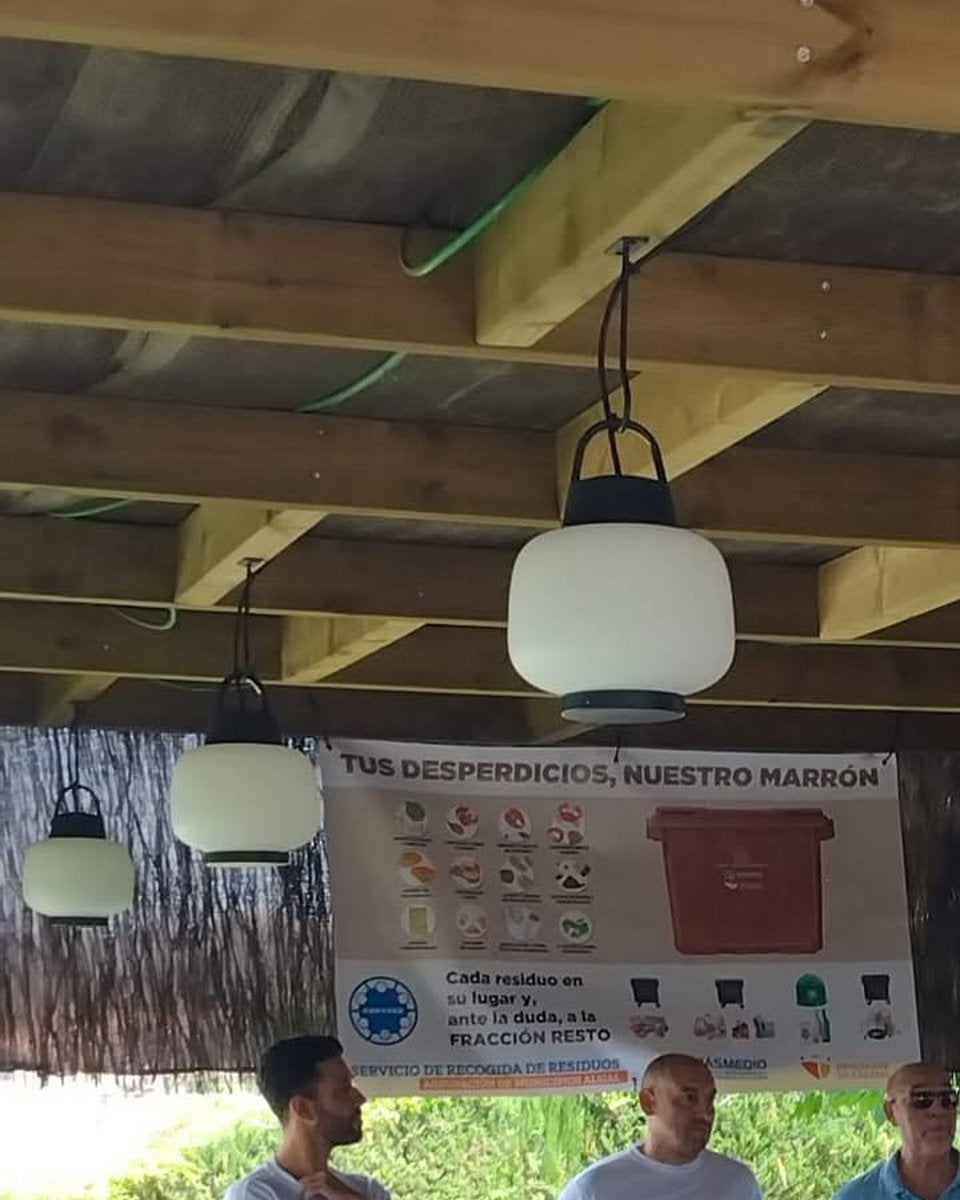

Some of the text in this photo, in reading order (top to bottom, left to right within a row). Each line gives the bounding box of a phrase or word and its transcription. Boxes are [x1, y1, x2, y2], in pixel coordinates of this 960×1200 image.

[341, 754, 879, 788] TUS DESPERDICIOS, NUESTRO MARRÓN
[446, 971, 583, 986] Cada residuo en
[447, 994, 467, 1005] su
[471, 992, 516, 1008] lugar
[448, 1010, 597, 1026] ante la duda, a la
[450, 1028, 611, 1047] FRACCIÓN RESTO
[351, 1059, 620, 1079] SERVICIO DE RECOGIDA DE RESIDUOS
